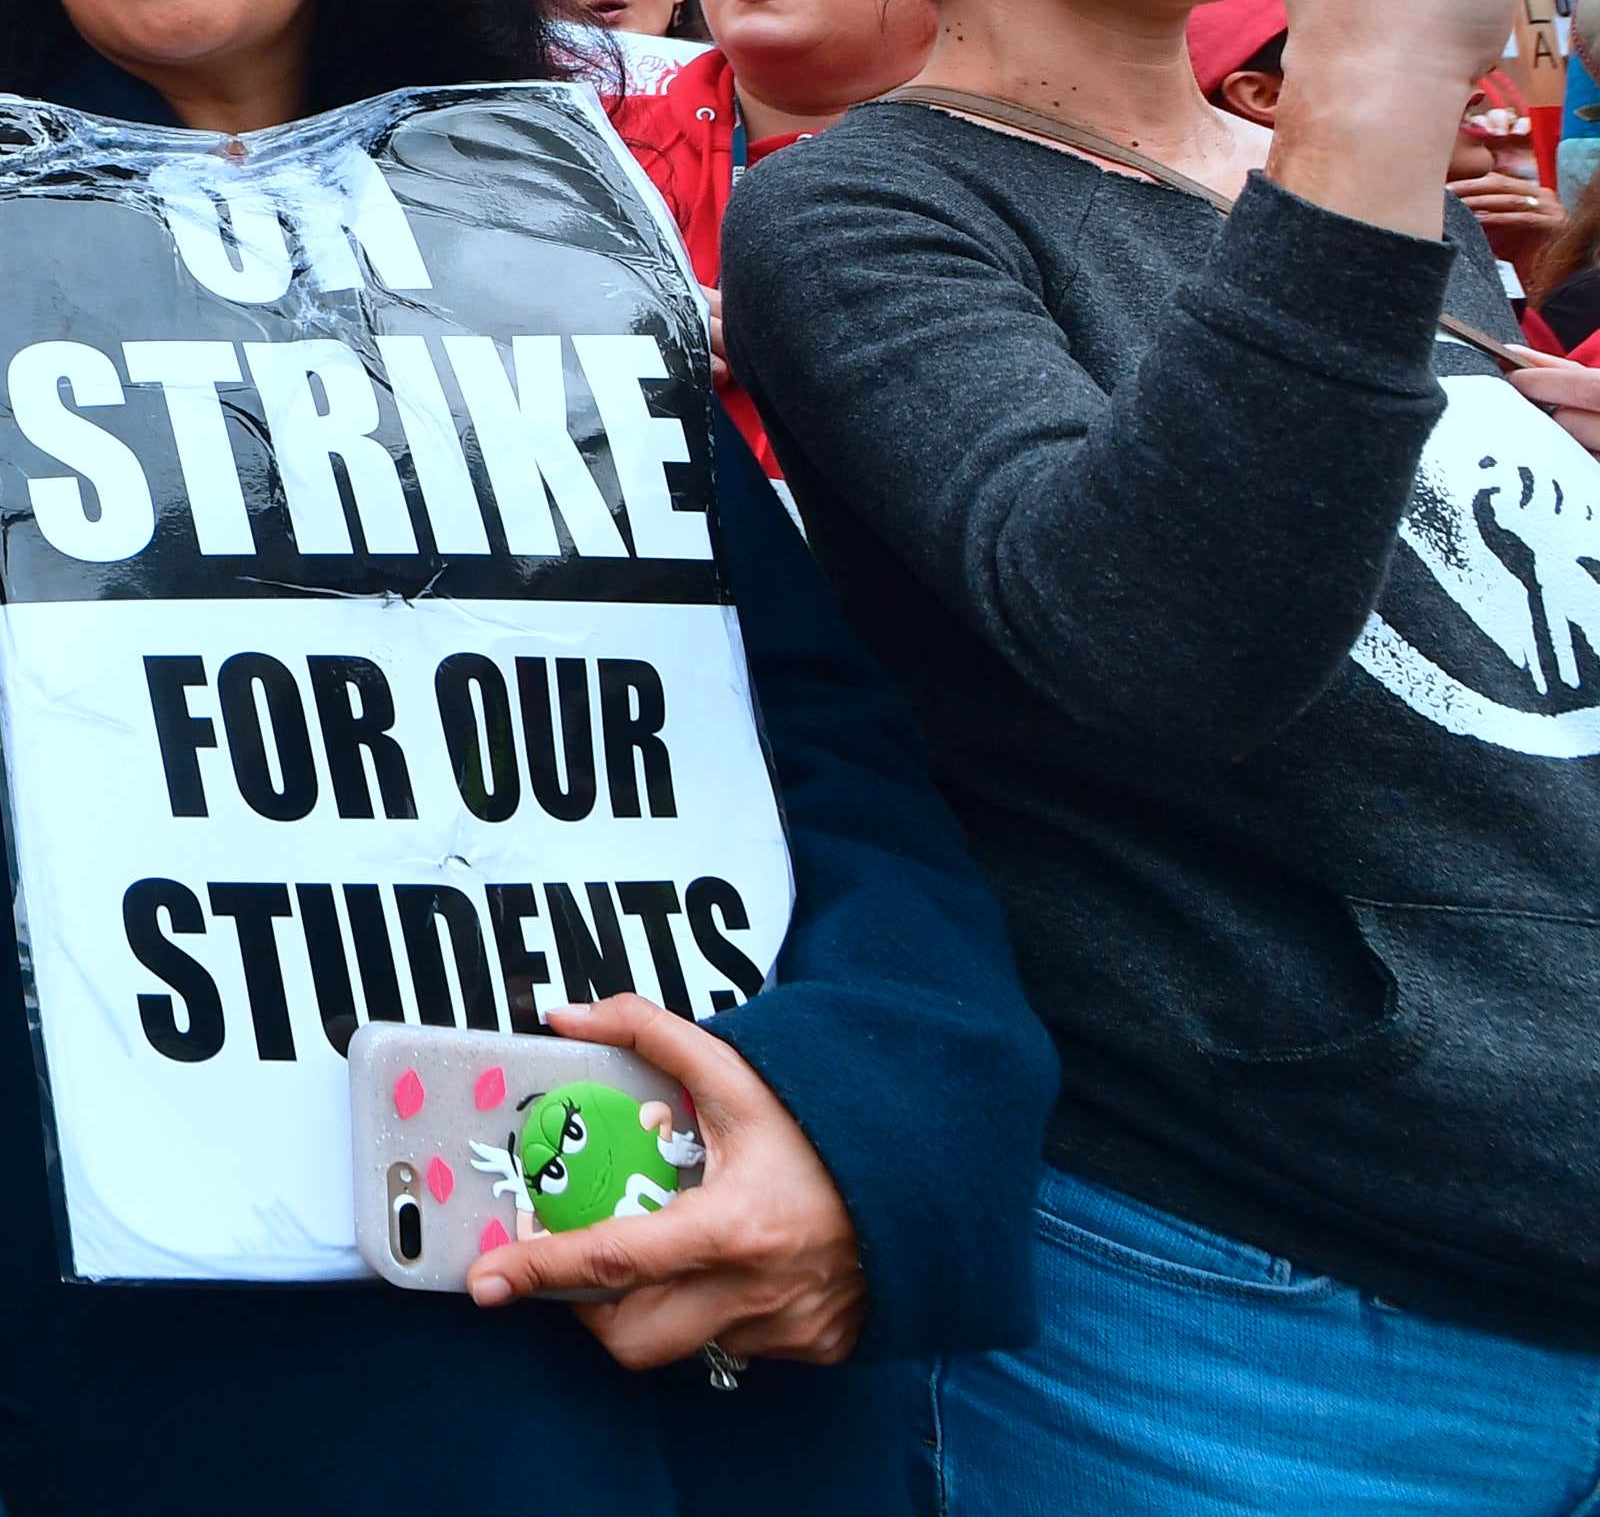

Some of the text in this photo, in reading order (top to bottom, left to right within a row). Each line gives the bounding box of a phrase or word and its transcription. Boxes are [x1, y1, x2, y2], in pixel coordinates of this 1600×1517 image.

[5, 333, 714, 563] STRIKE
[142, 650, 678, 823] FOR OUR
[122, 874, 768, 1064] STUDENTS
